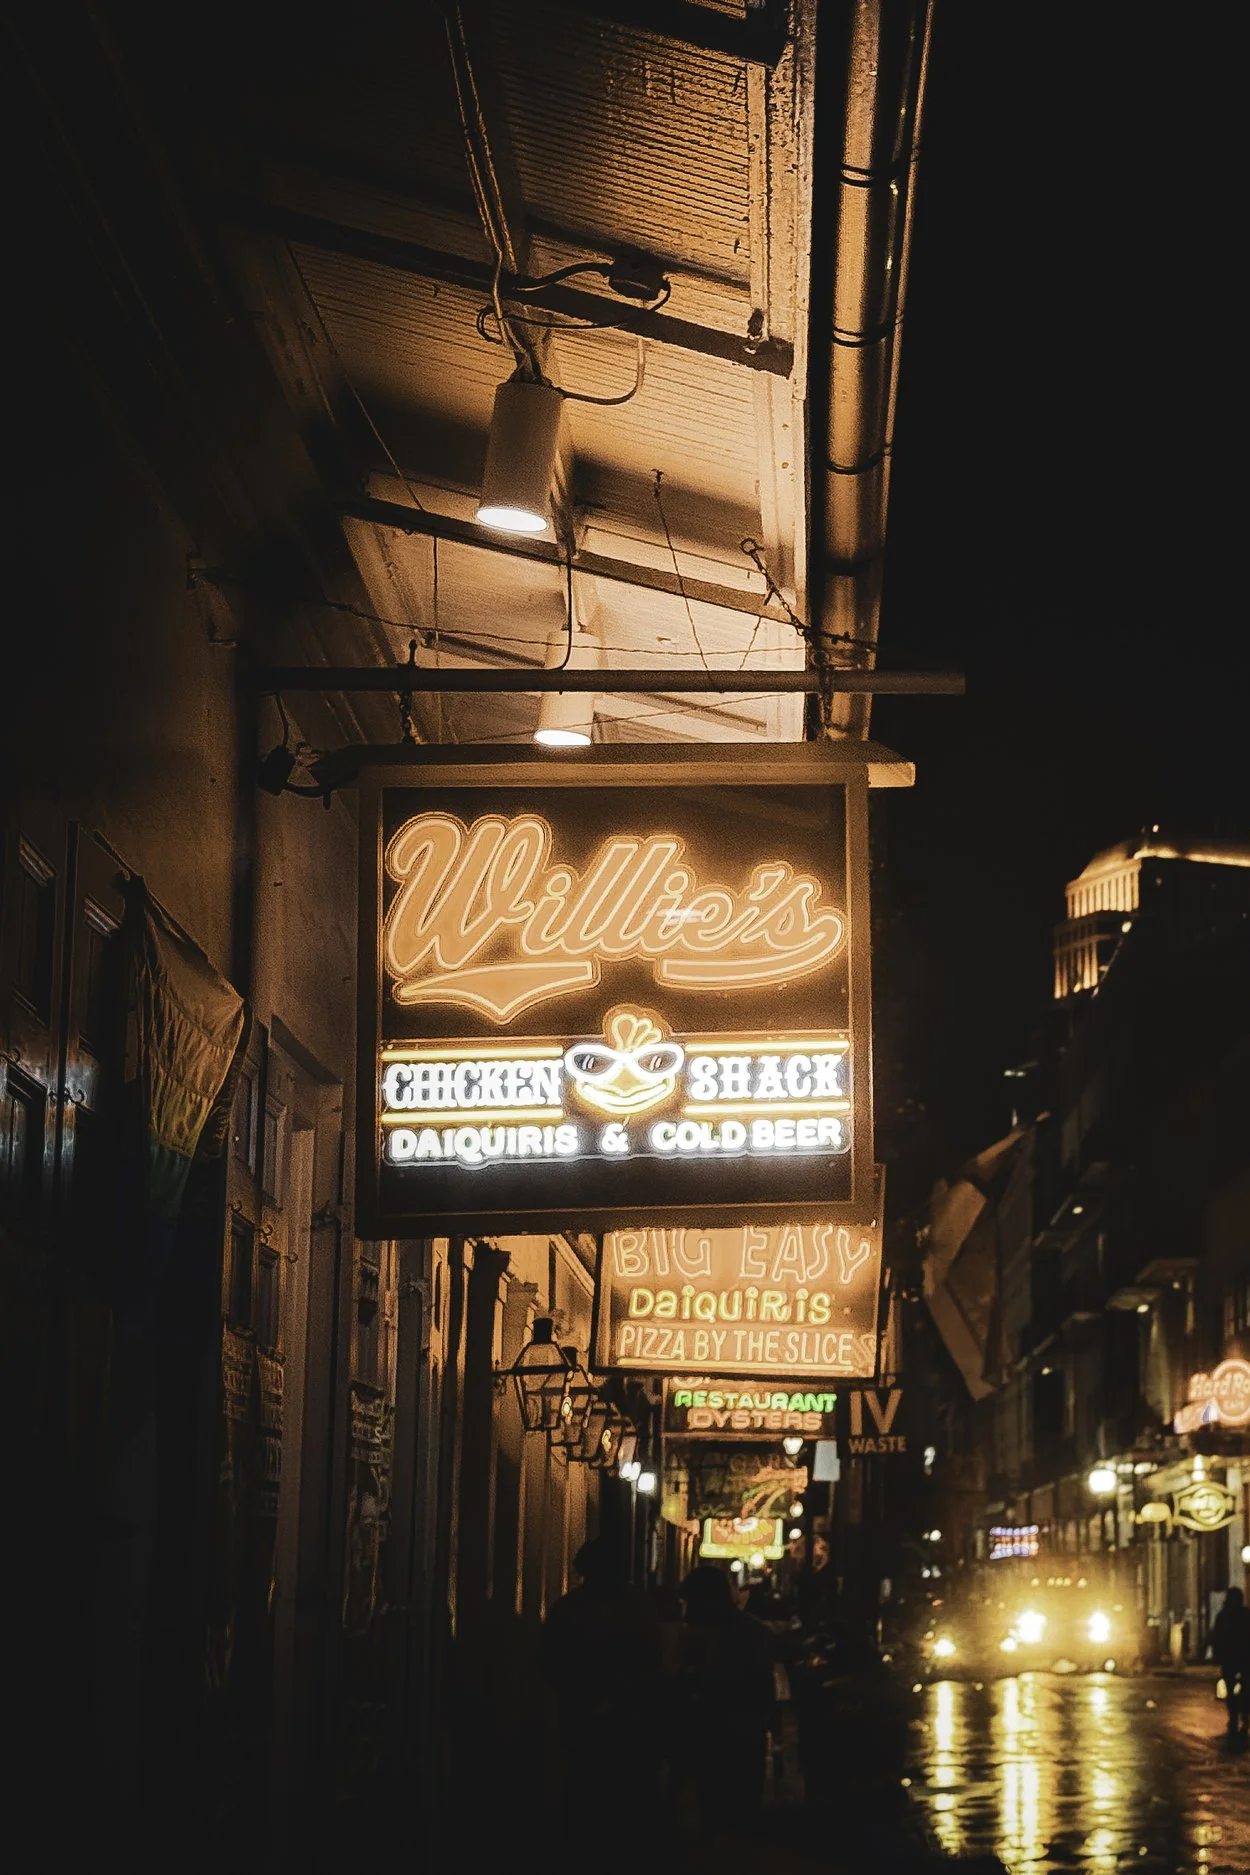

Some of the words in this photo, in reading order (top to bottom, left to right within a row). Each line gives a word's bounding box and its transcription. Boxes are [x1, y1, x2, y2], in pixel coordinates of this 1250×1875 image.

[384, 812, 846, 974] Willie's
[382, 1060, 564, 1110] CHICKEN
[689, 1055, 844, 1100] SHACK
[390, 1125, 579, 1162] DAIQUIRIS
[600, 1122, 630, 1153] &
[652, 1119, 746, 1151] COLD
[752, 1117, 842, 1148] BEER
[612, 1228, 712, 1277] BIG
[739, 1226, 872, 1284] EASY
[620, 1325, 685, 1361] PIZZA
[693, 1330, 727, 1361] BY
[733, 1331, 780, 1363] THE
[785, 1332, 853, 1365] SLICE
[674, 1390, 838, 1413] RESTAURANT
[687, 1409, 823, 1430] OYSTERS
[849, 1389, 903, 1435] IV
[849, 1436, 907, 1453] WASTE
